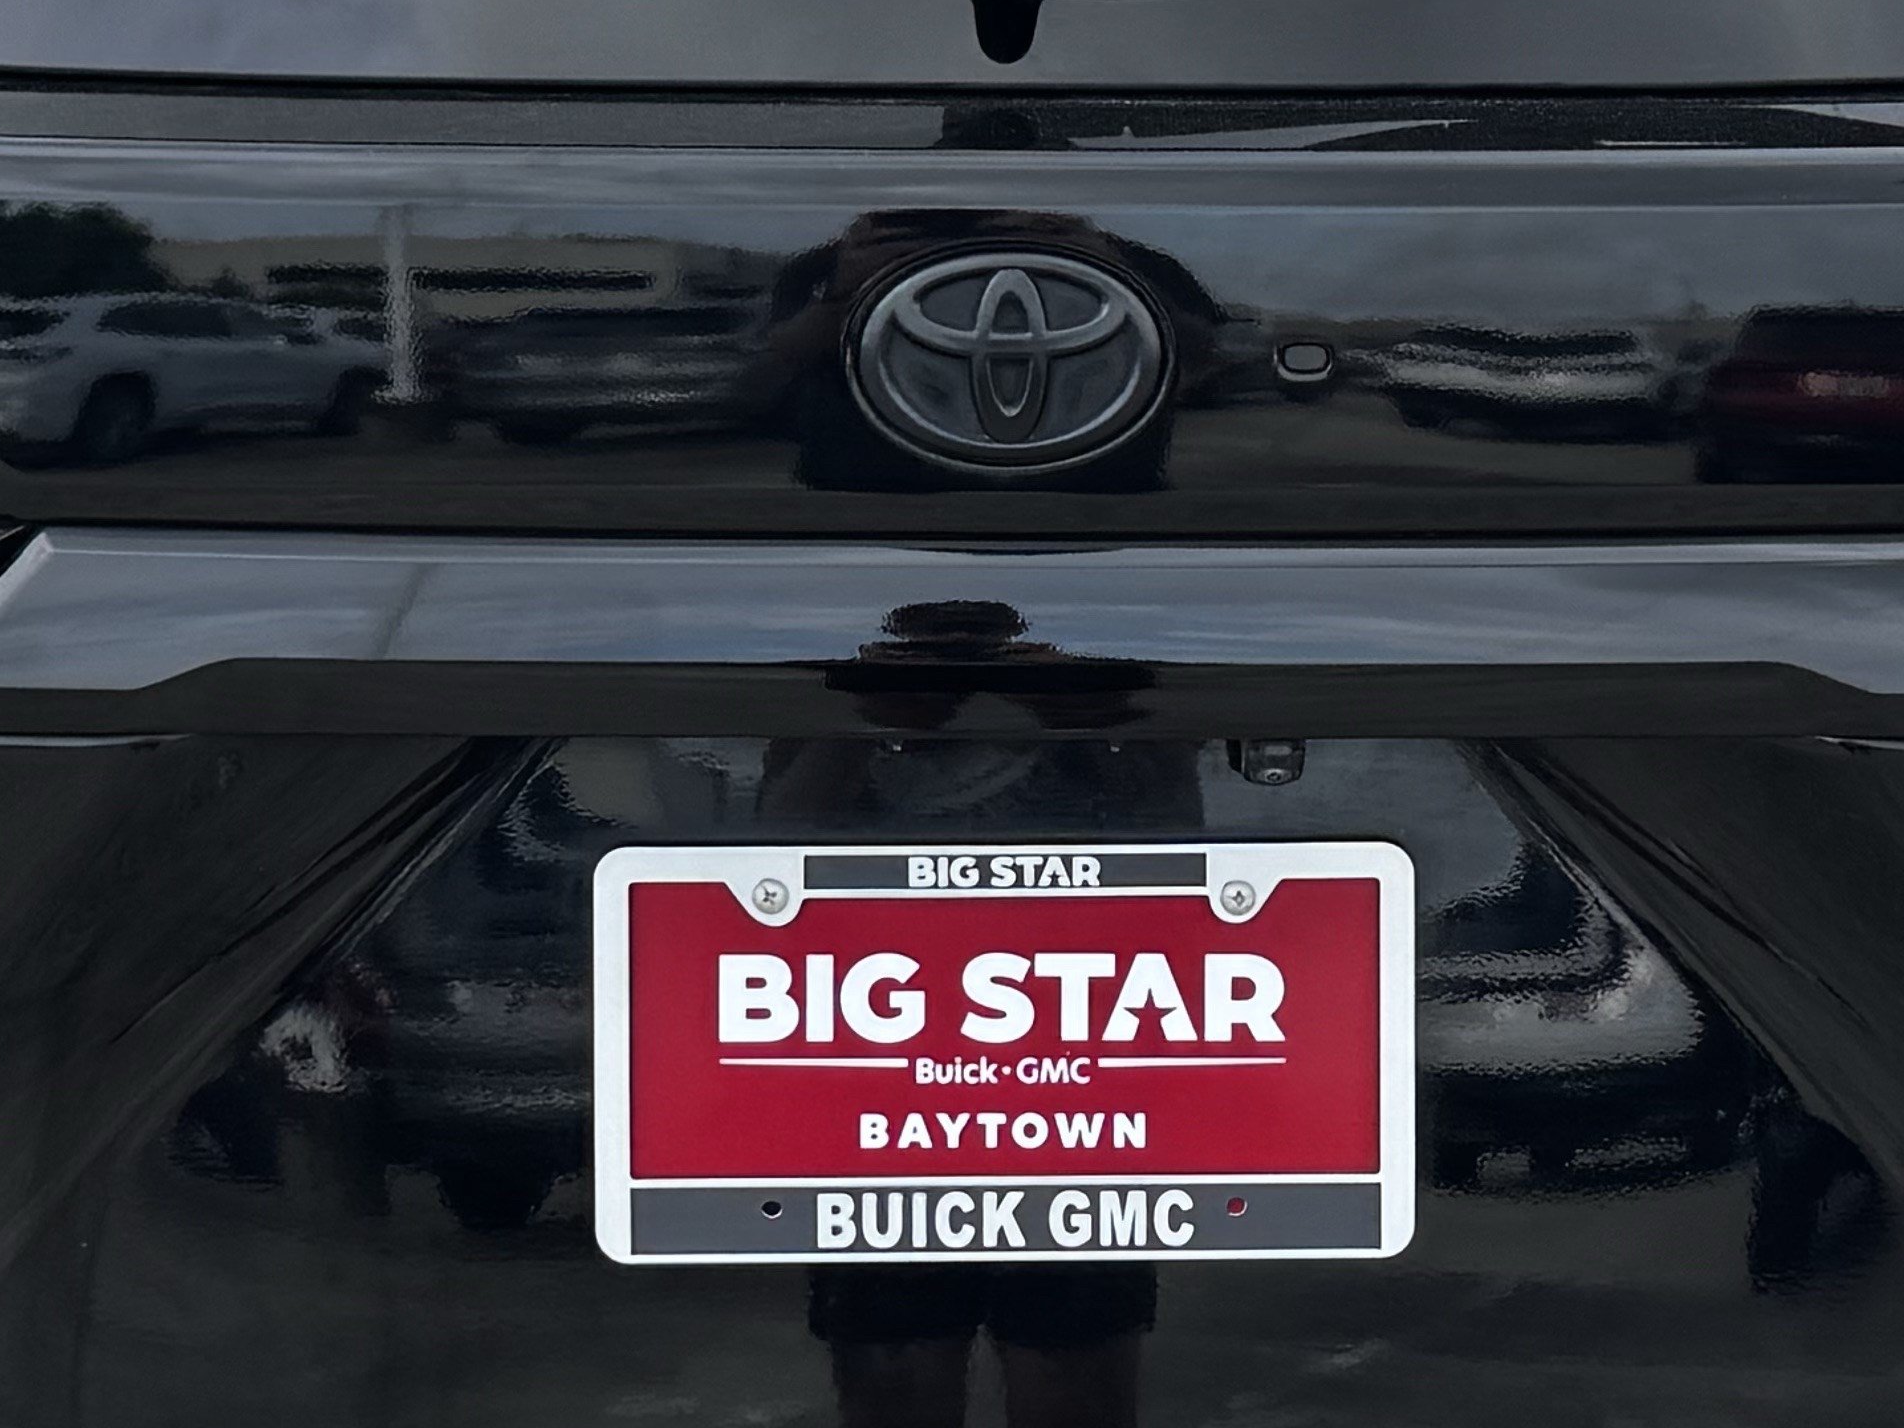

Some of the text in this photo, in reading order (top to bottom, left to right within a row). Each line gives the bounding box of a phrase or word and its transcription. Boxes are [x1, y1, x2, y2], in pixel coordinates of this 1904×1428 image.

[907, 855, 1102, 888] BIG STAR
[717, 952, 1287, 1045] BIG STAR
[858, 1112, 1147, 1150] BAYTOWN
[815, 1189, 1196, 1250] BUICK GMC
